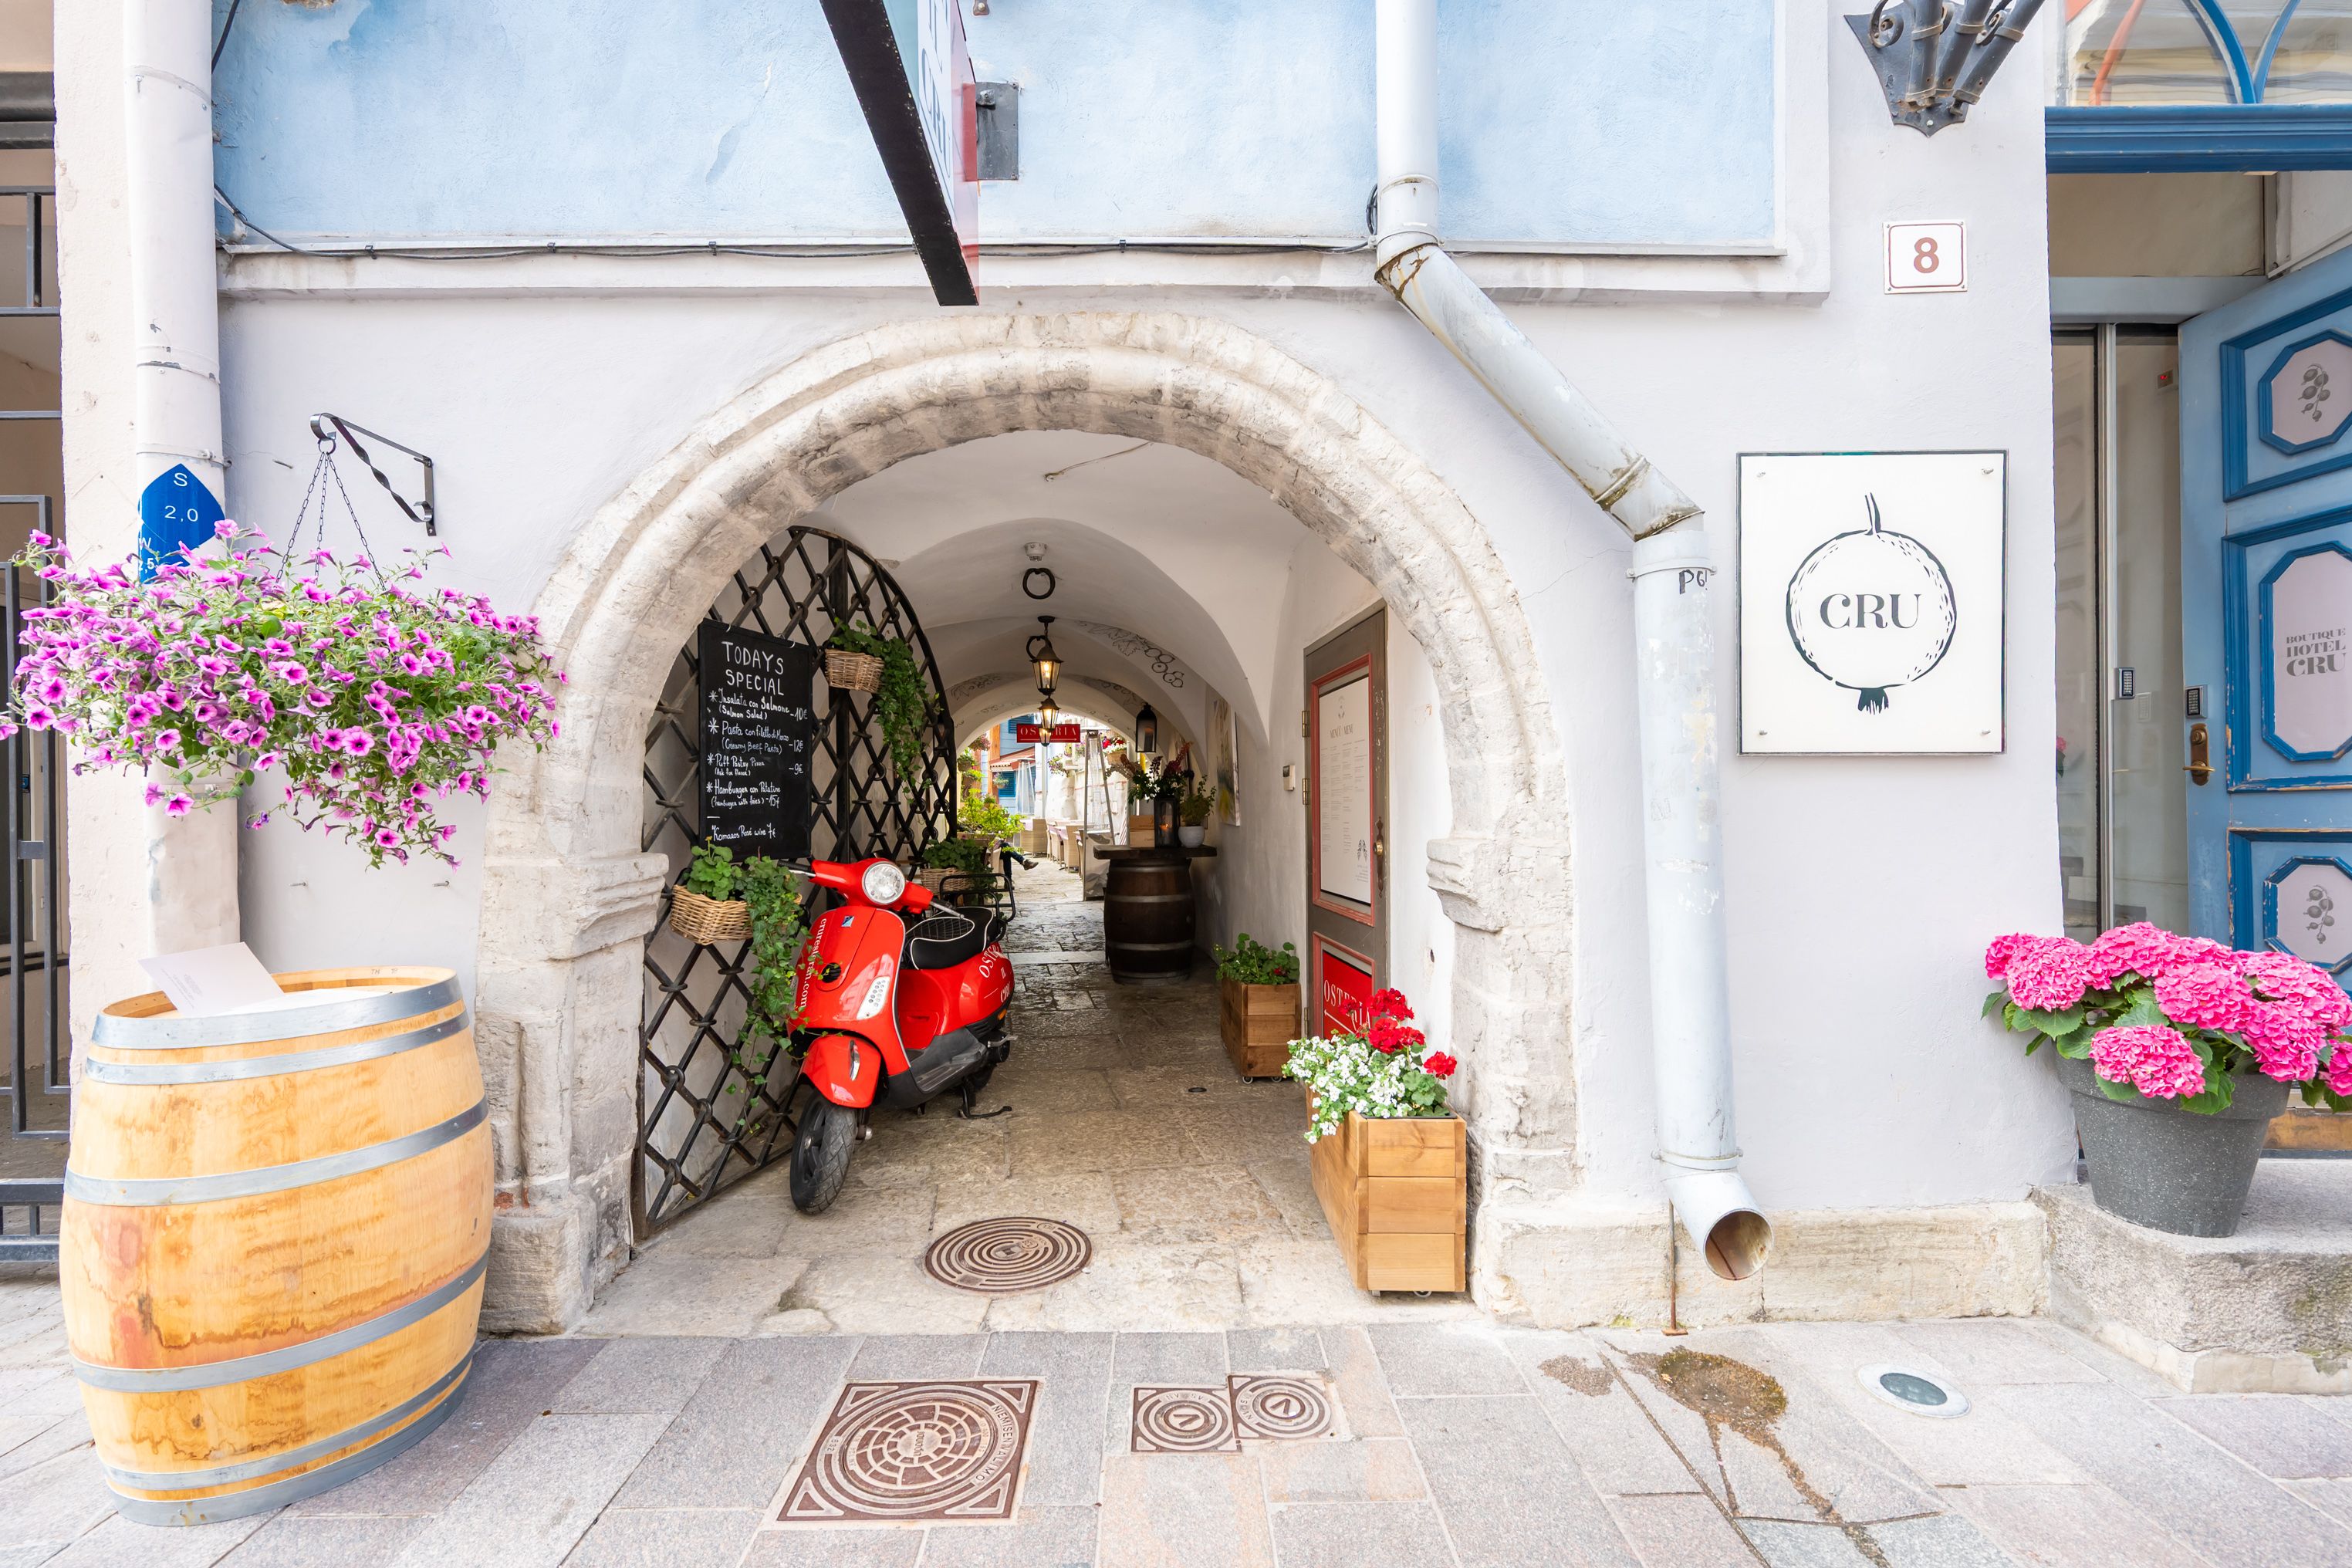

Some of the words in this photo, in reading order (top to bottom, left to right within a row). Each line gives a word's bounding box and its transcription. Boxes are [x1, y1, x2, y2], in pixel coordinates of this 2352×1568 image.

[921, 48, 951, 178] CRU
[1912, 236, 1940, 274] 8
[173, 472, 188, 487] S
[164, 505, 199, 522] 2,0
[1820, 593, 1921, 630] CRU
[2286, 627, 2346, 644] BOUTIQUE
[721, 641, 784, 674] TODAYS
[2286, 640, 2347, 658] HOTEL
[2286, 652, 2347, 677] CRU
[725, 669, 784, 696] SPECIAL
[718, 688, 747, 706] Insalata
[760, 695, 789, 713] Salmone
[721, 720, 743, 735] Pasta
[1019, 726, 1077, 736] OSRIA
